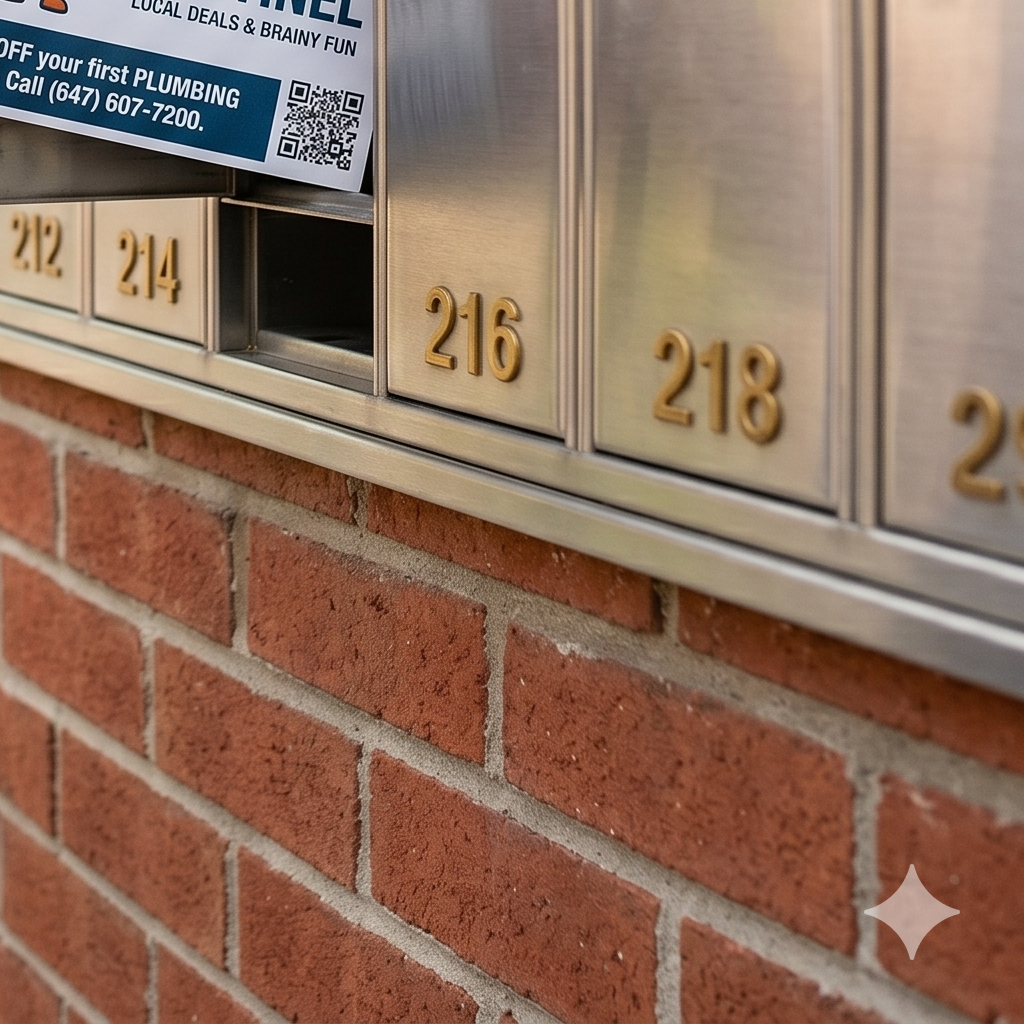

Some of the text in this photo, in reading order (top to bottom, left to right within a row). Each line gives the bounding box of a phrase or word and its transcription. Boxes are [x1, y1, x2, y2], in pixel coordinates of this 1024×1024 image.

[187, 5, 240, 31] DEALS
[243, 18, 256, 35] &
[260, 21, 321, 49] BRAINY
[324, 36, 357, 57] FUN
[5, 70, 45, 97] Call
[48, 79, 101, 113] (647)
[105, 92, 204, 132] 607-7200.
[36, 50, 84, 75] your
[87, 57, 129, 85] first
[132, 67, 241, 109] PLUMBING
[11, 212, 62, 278] 212
[117, 229, 181, 305] 214
[425, 285, 523, 382] 216
[652, 328, 784, 446] 218
[949, 385, 1024, 507] 2
